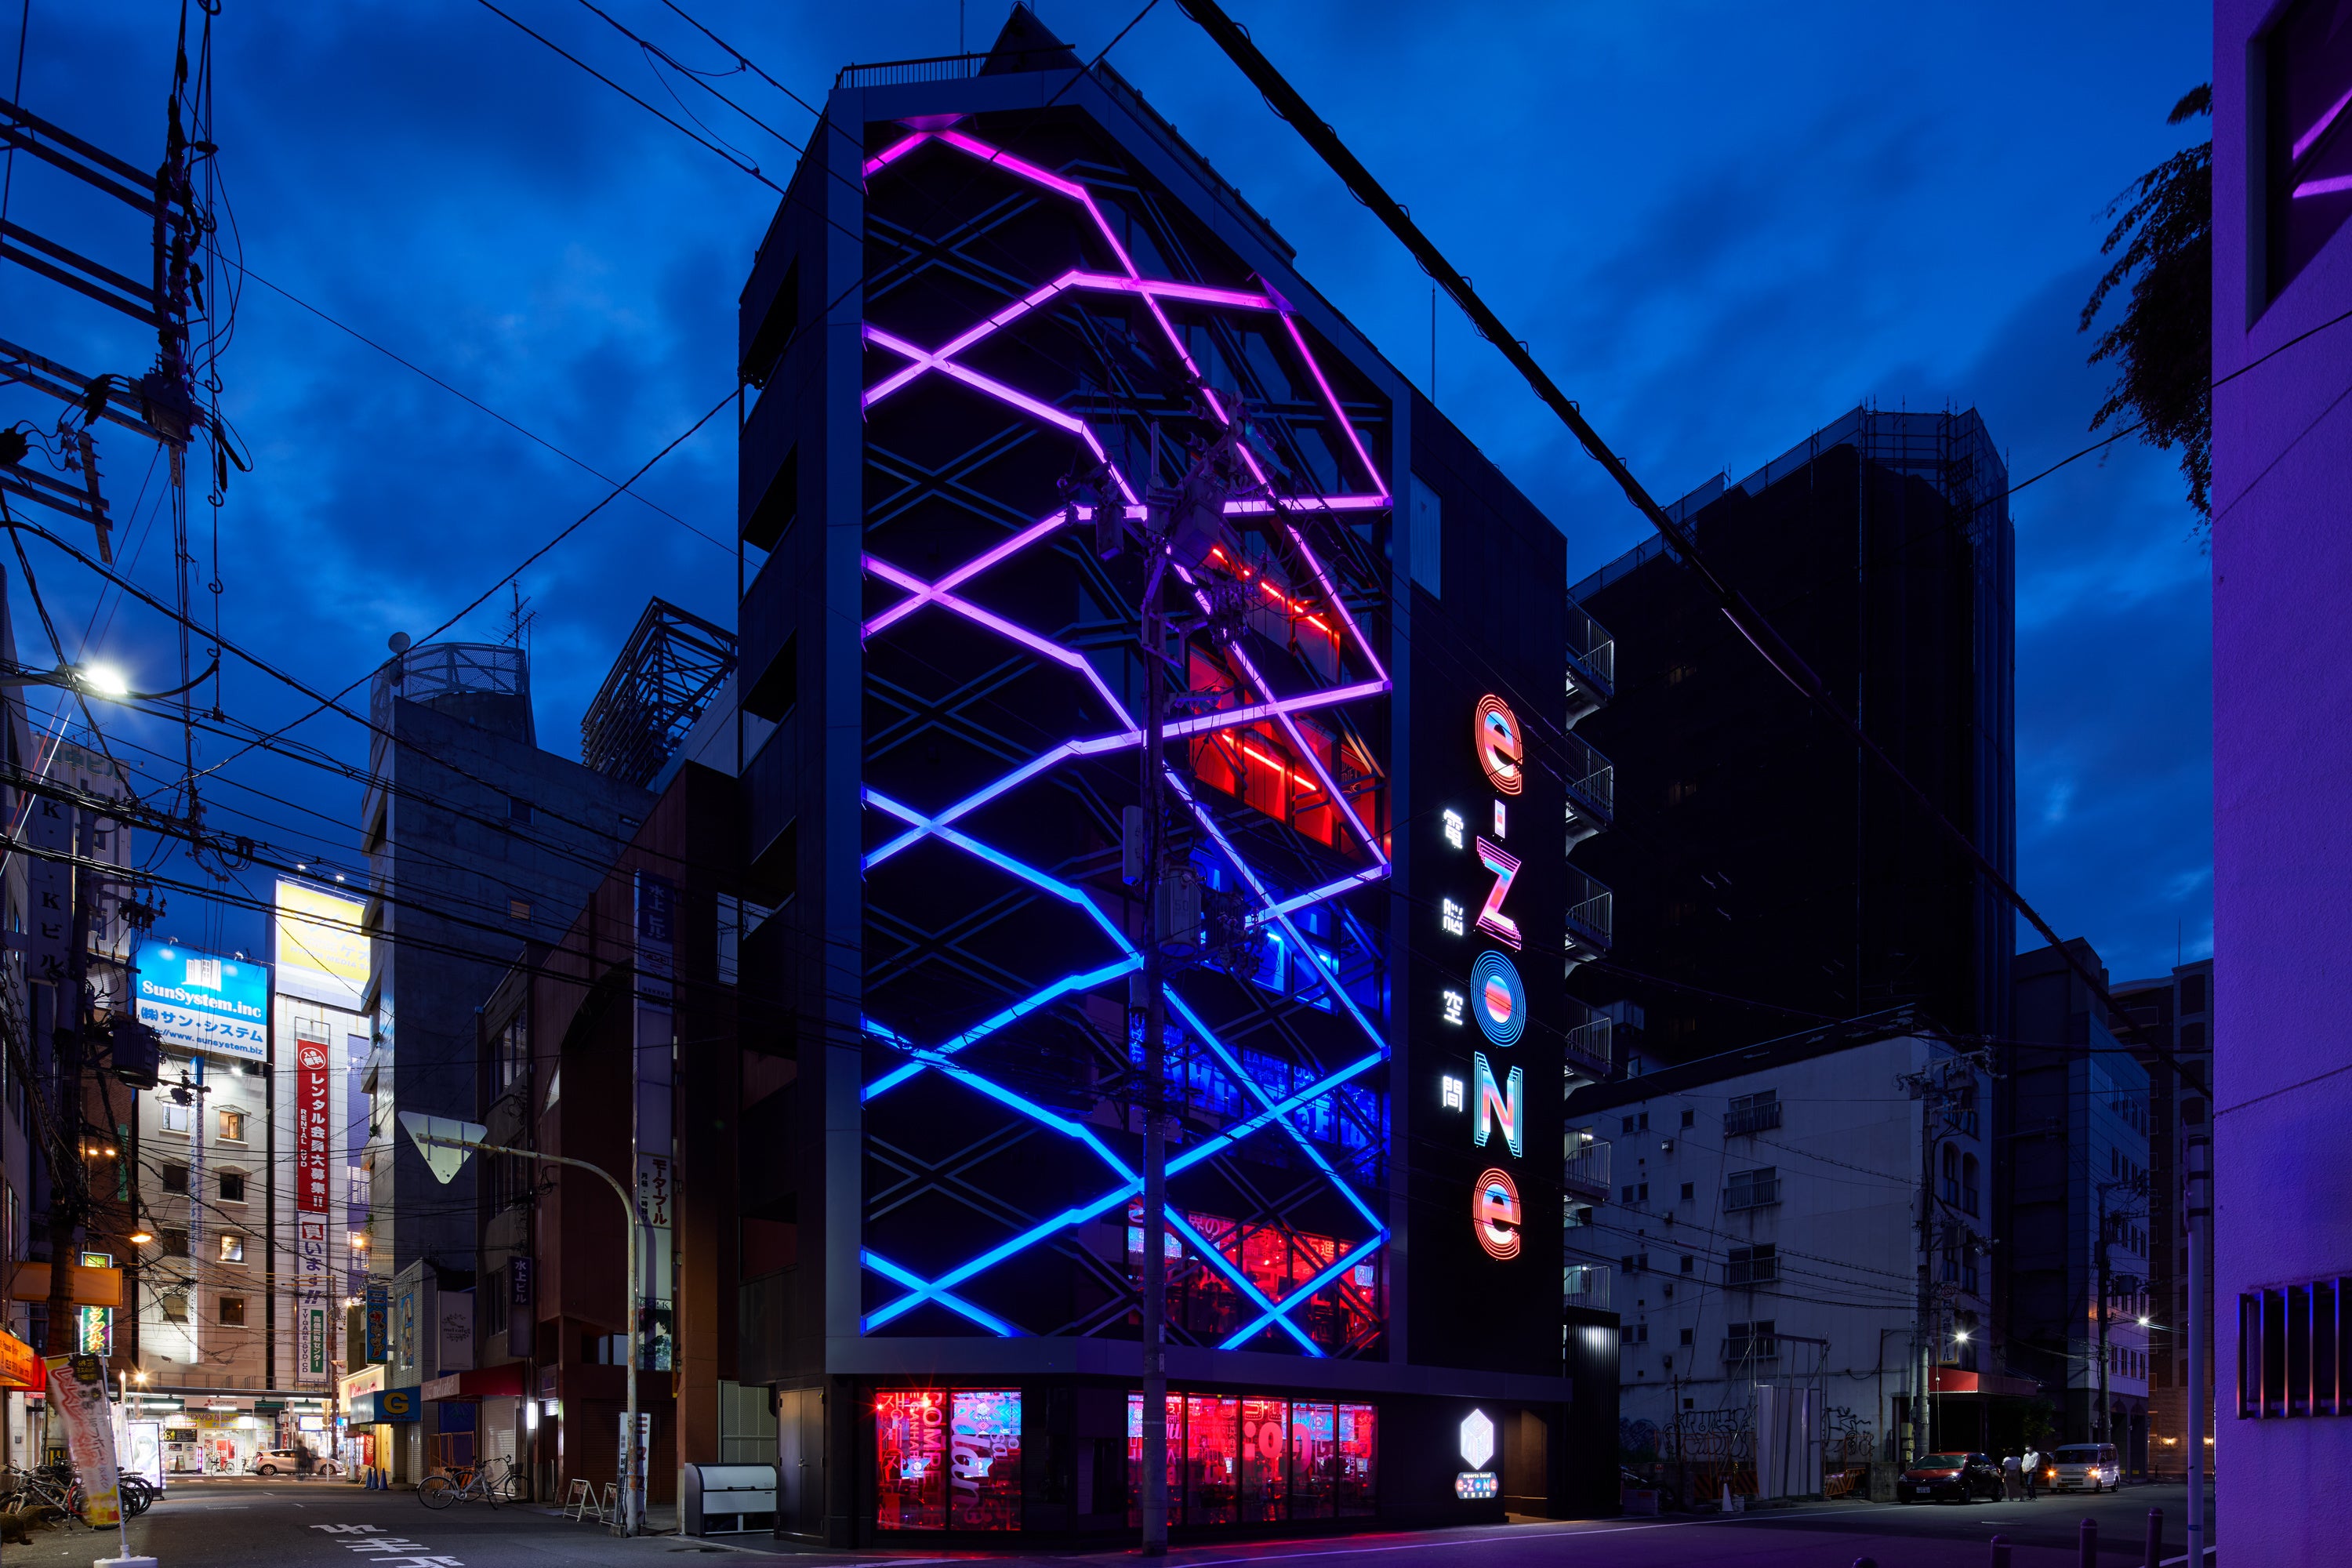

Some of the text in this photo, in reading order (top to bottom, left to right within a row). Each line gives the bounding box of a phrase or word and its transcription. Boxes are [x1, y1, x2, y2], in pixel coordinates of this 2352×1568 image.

[648, 884, 666, 939] 水上ビル
[326, 955, 357, 967] MEDIA
[1443, 809, 1464, 1112] 電脳空間
[142, 980, 262, 1018] SunSystem.inc
[652, 1159, 667, 1225] モータープール
[514, 1260, 527, 1303] 水上ビル
[383, 1392, 409, 1415] G
